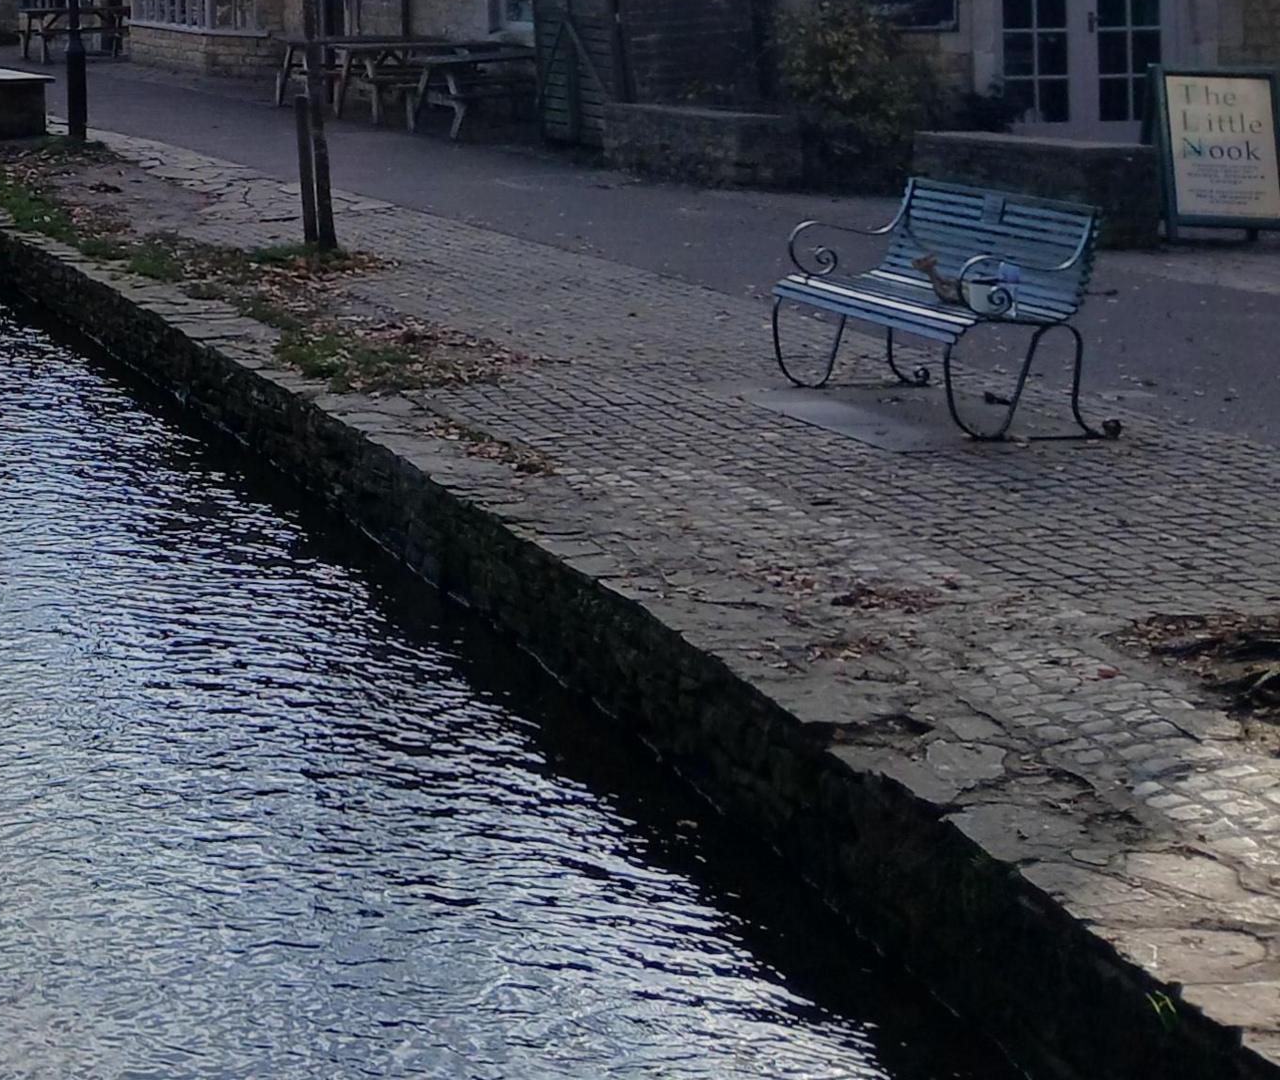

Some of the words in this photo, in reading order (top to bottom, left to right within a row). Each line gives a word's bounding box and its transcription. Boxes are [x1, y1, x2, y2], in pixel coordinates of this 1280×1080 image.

[1178, 83, 1237, 107] The
[1181, 109, 1263, 134] Little
[1182, 137, 1262, 161] Nook
